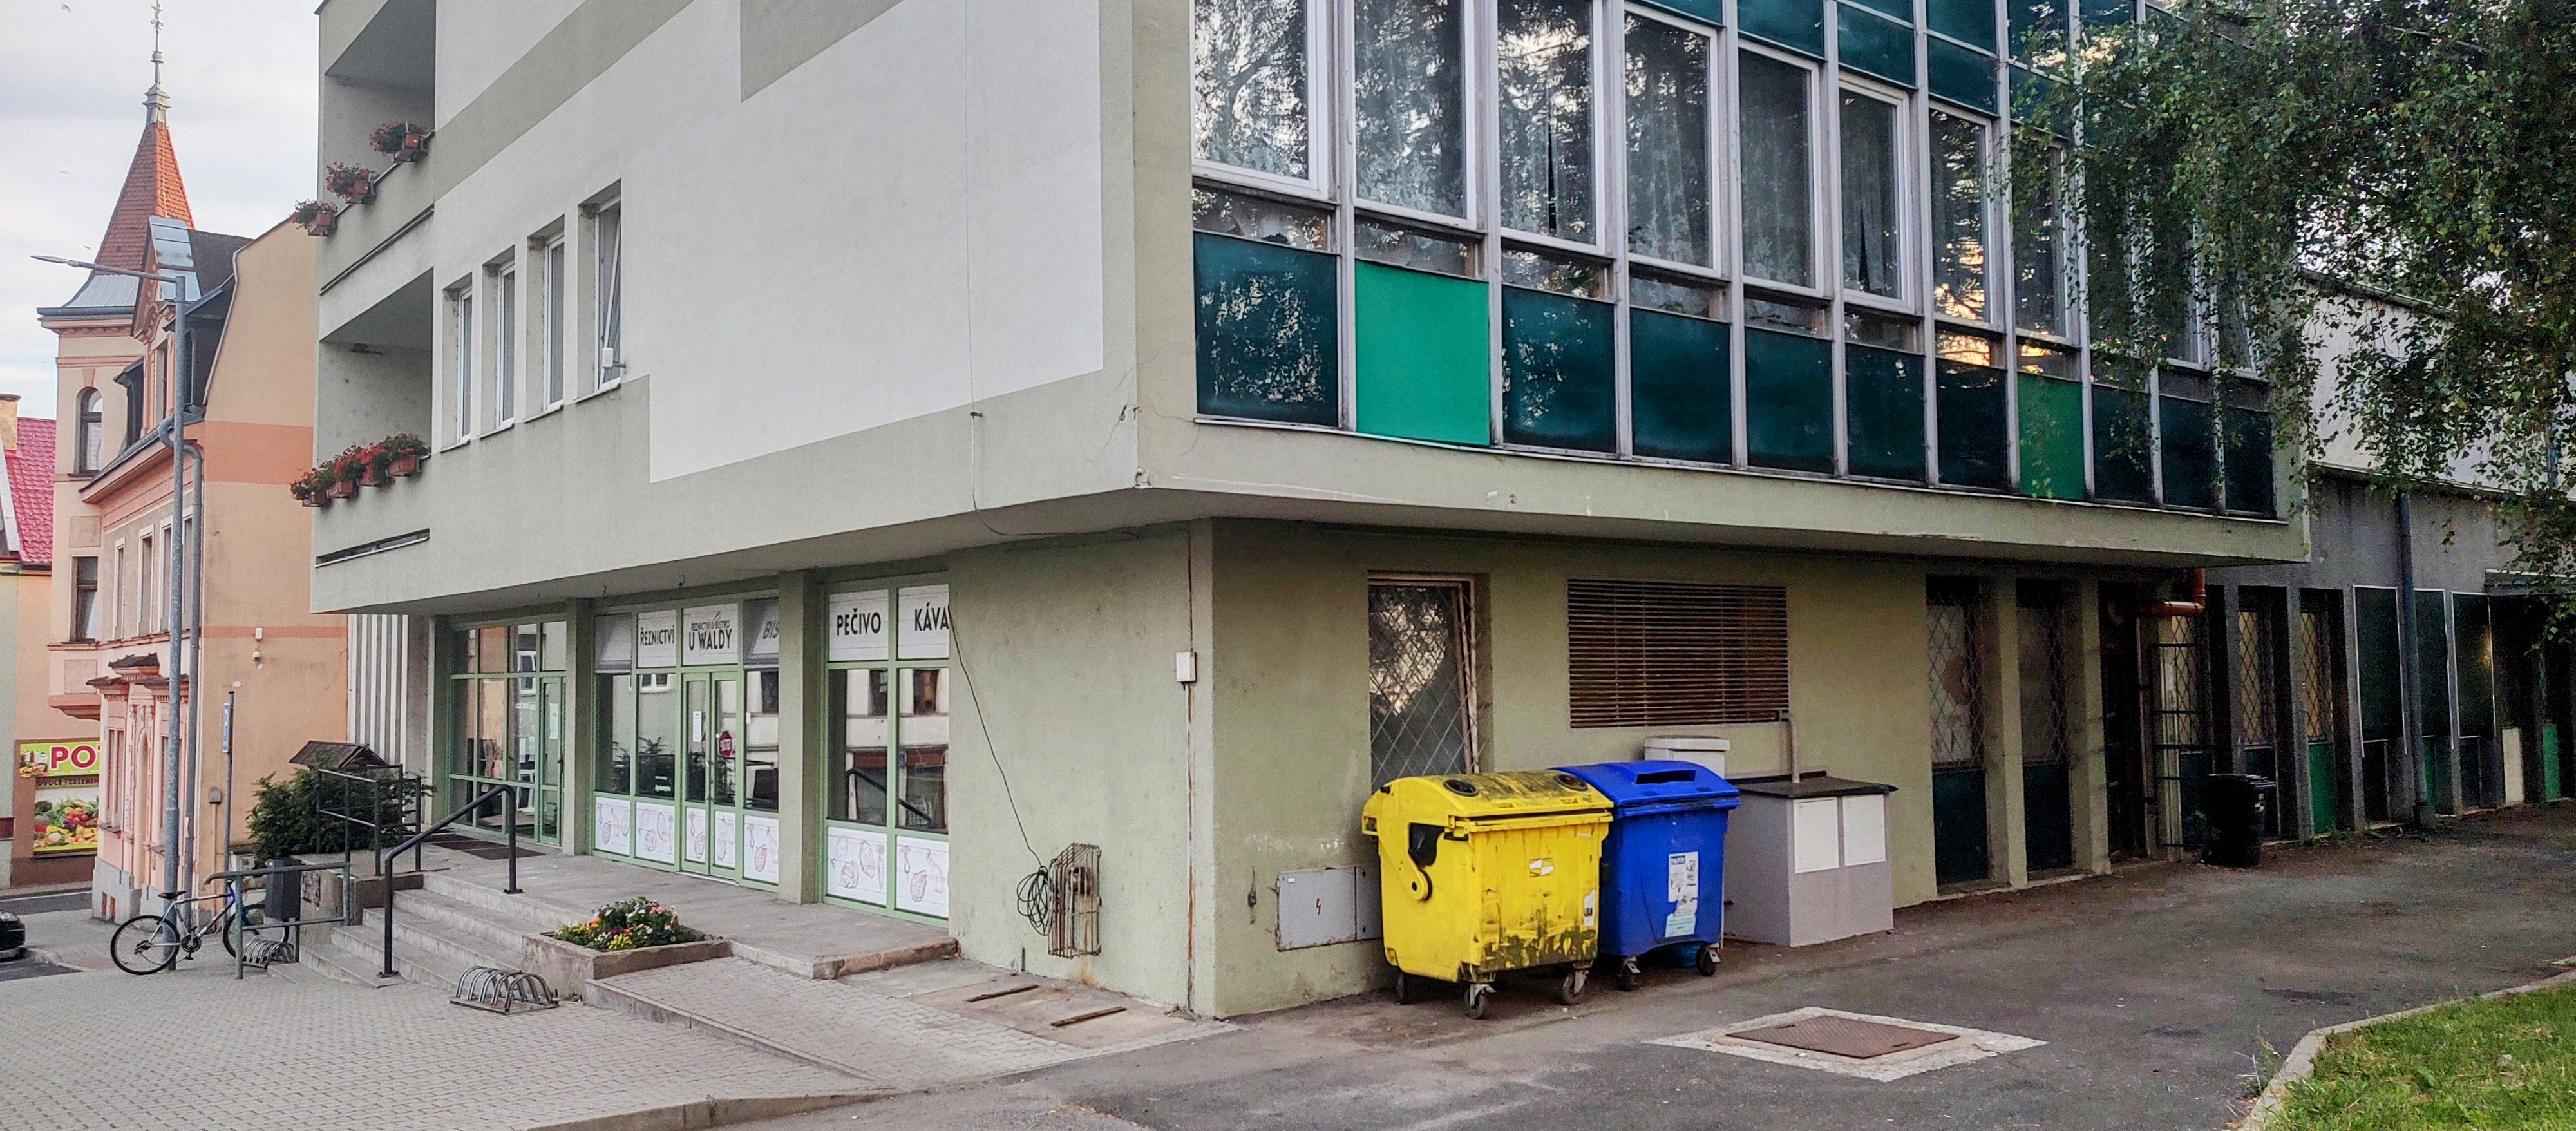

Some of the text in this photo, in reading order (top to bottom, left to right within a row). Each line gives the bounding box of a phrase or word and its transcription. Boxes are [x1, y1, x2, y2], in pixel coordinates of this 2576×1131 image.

[837, 608, 881, 636] PEČIVO
[915, 602, 950, 631] KÁVA
[640, 625, 675, 646] ŘEZNICTVÍ
[689, 628, 732, 651] U WALDY
[51, 745, 100, 770] PO
